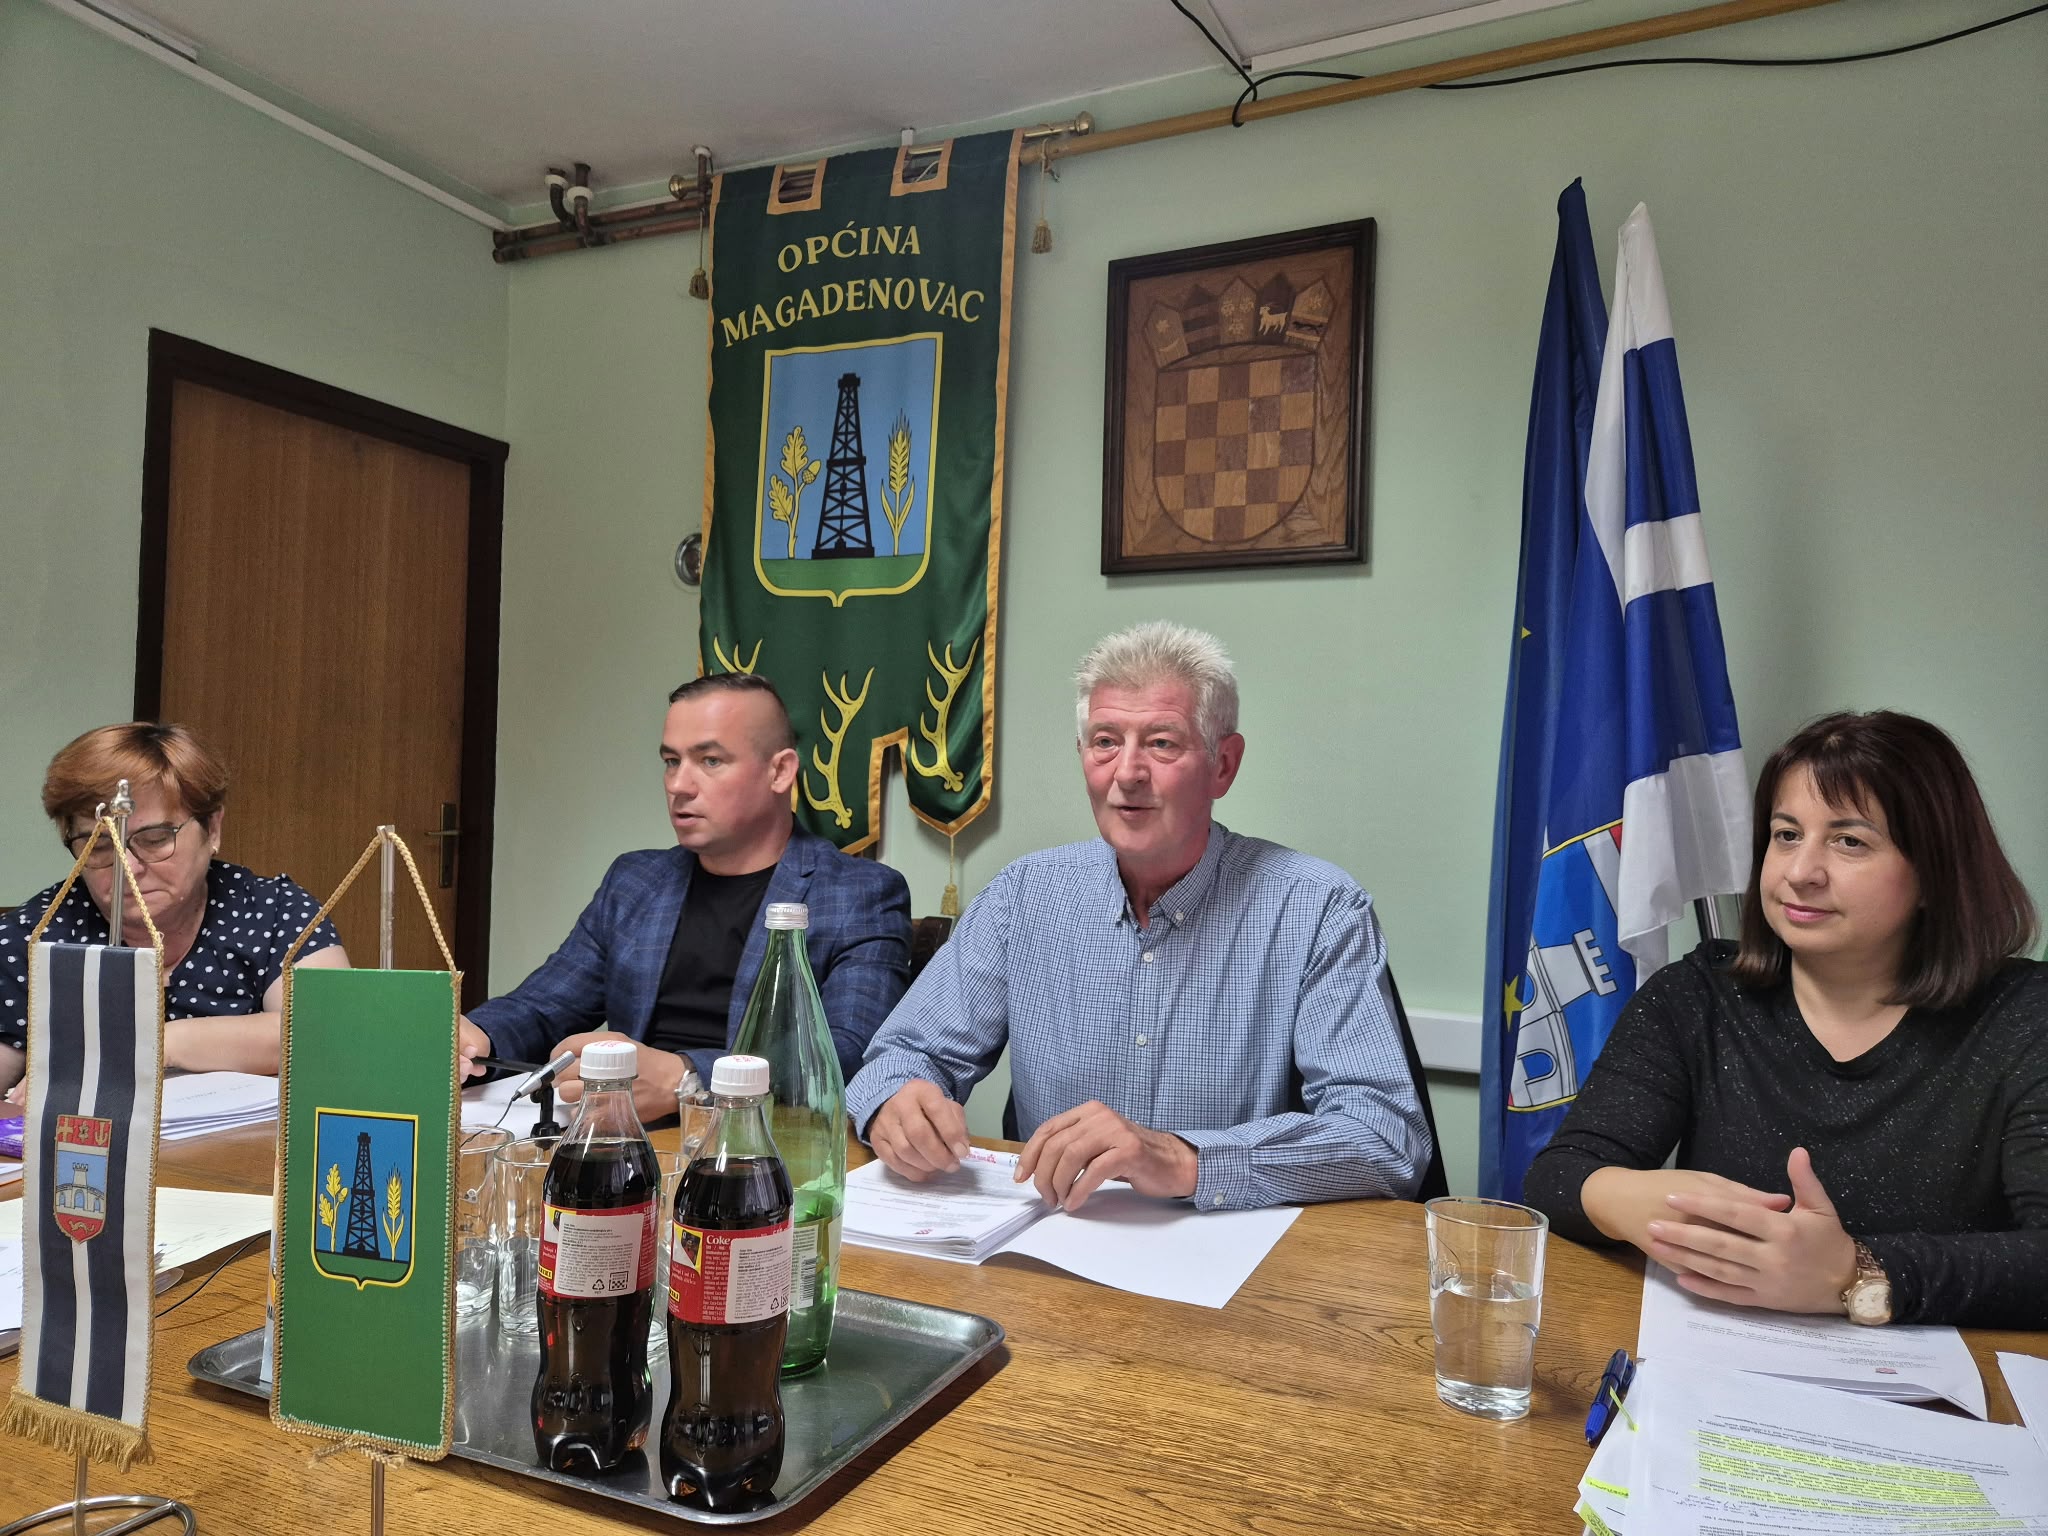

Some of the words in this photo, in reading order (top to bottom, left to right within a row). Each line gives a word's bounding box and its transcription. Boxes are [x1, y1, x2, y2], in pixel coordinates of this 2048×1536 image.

[777, 220, 921, 273] OPĆINA
[720, 277, 985, 348] MAGADENOVAC
[706, 1234, 731, 1245] Coke
